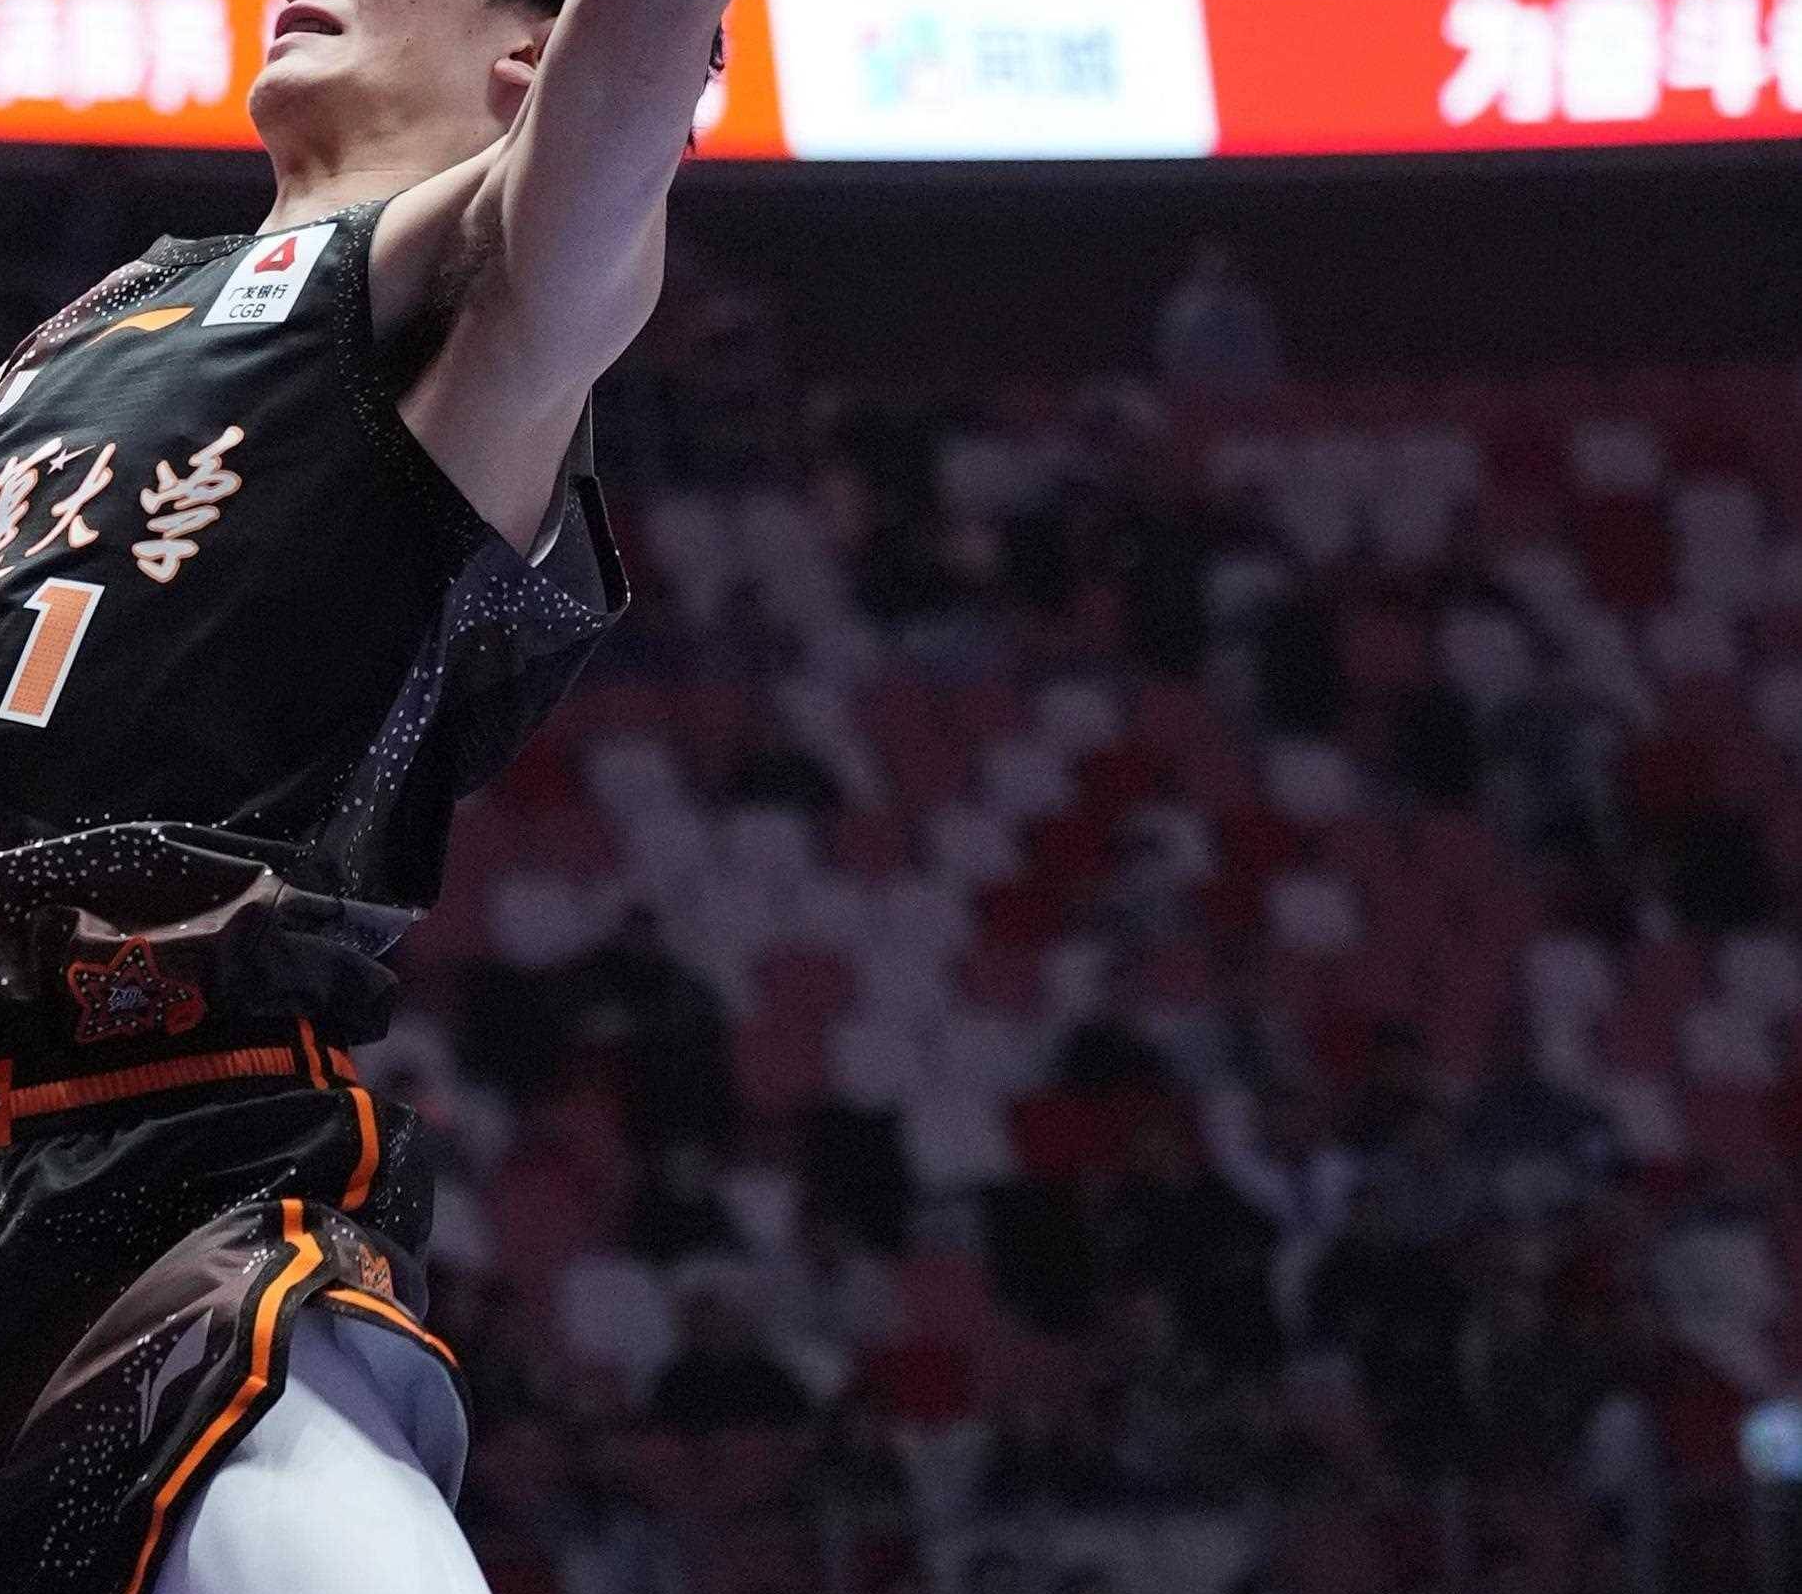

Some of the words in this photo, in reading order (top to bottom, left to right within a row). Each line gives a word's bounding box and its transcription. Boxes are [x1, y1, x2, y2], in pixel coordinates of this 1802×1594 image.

[228, 284, 289, 302] 广发银行
[228, 303, 267, 319] CGB
